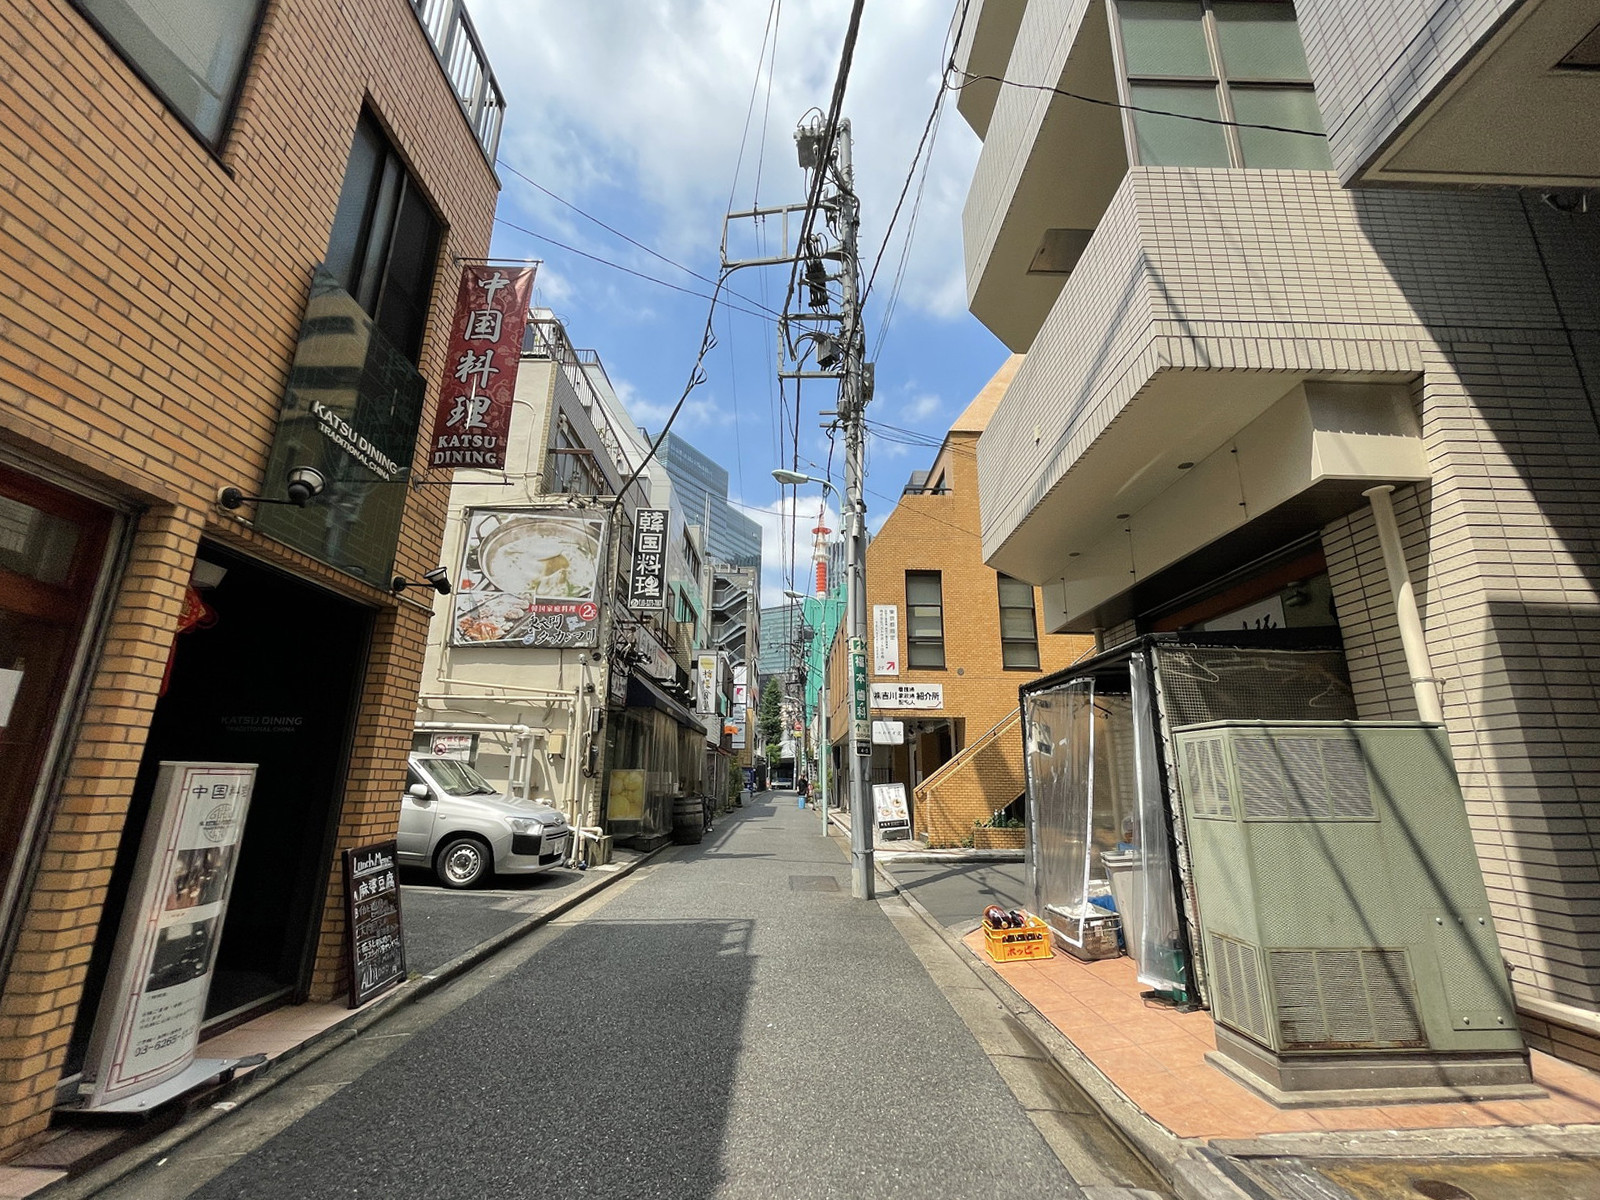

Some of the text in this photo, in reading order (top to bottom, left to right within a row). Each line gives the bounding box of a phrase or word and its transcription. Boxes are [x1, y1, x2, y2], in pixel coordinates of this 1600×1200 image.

[446, 272, 510, 430] 中国料理
[313, 400, 398, 475] KATSU DINING
[319, 421, 391, 482] TRADITIONAL CHINA
[437, 435, 497, 450] KATSU
[434, 450, 498, 465] DINING
[634, 511, 665, 597] 韓国料理
[221, 716, 304, 726] KATSU DINING
[353, 853, 375, 874] Lunch
[359, 871, 395, 901] 麻婆豆腐
